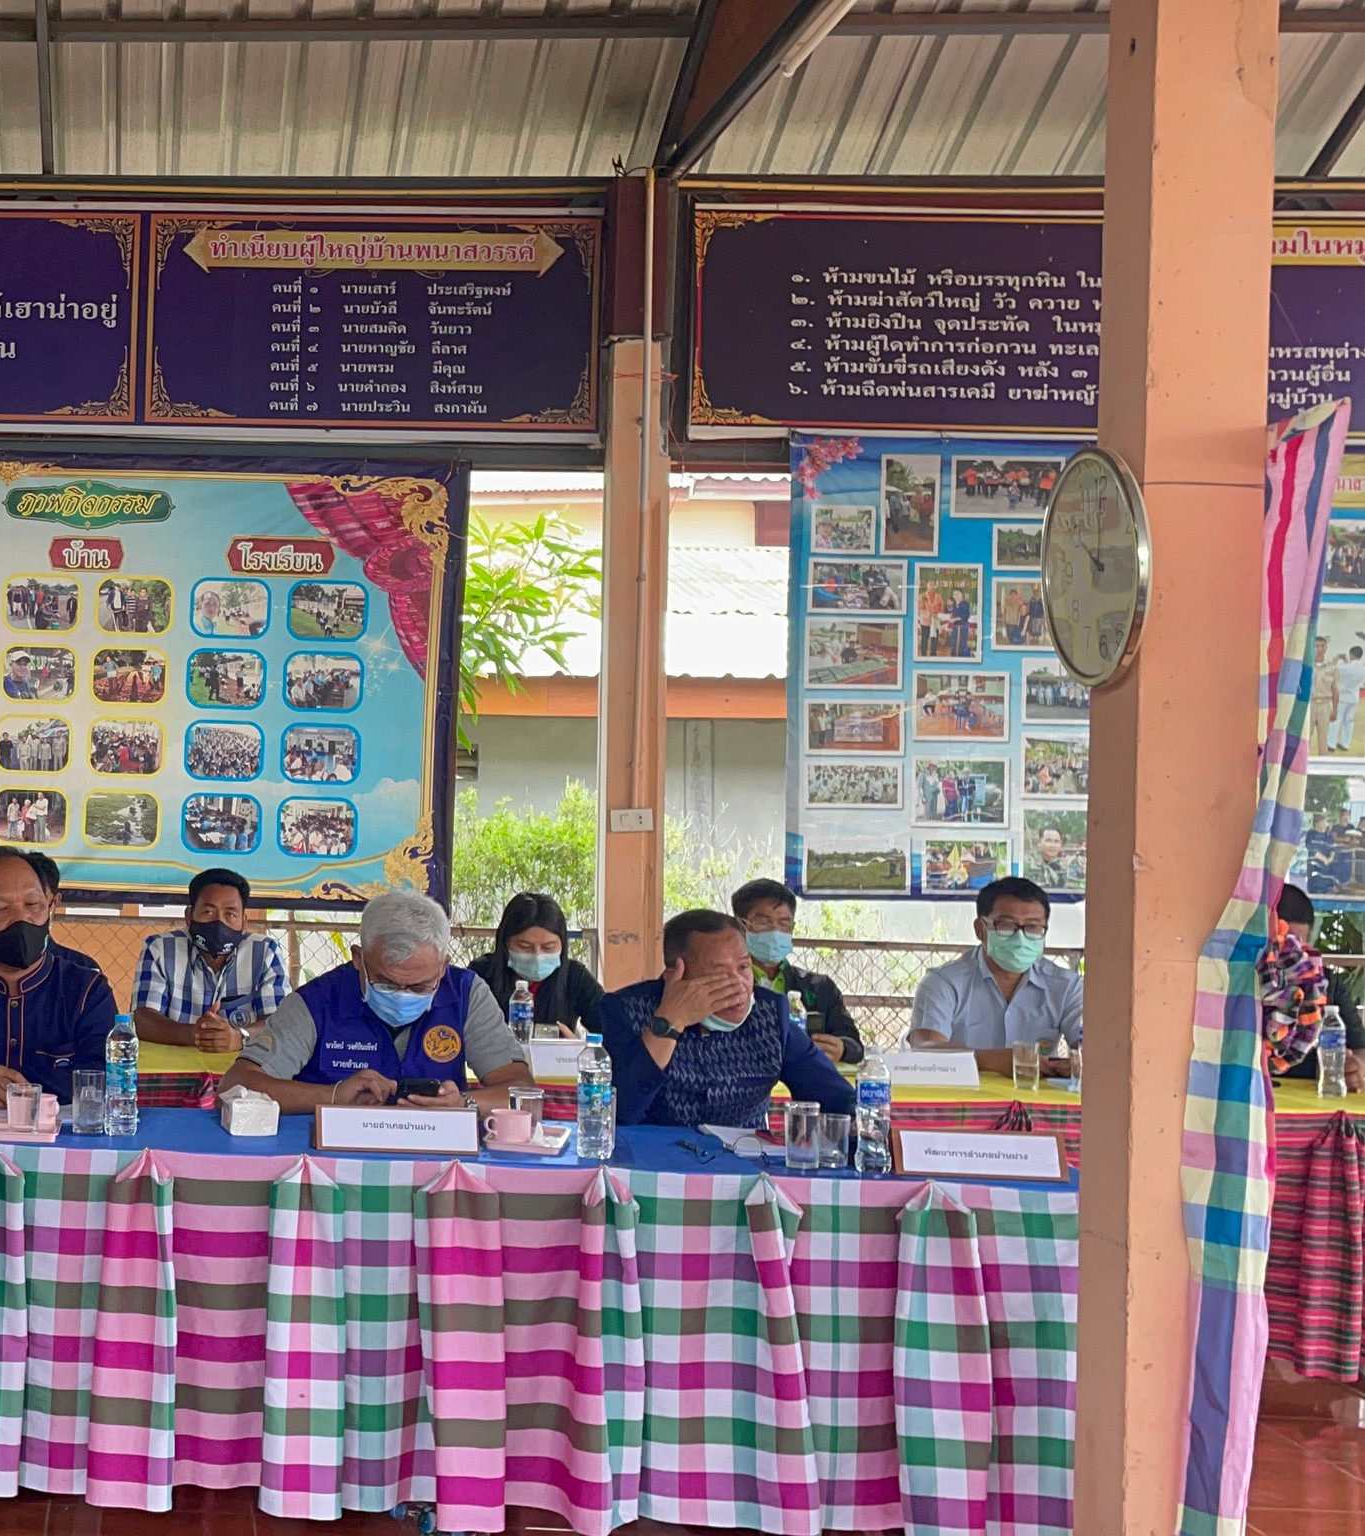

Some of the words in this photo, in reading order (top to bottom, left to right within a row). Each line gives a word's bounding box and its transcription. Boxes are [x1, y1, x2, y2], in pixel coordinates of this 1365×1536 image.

[210, 233, 535, 265] ทำเนียบผู้ใหญ่บ้านพนาสวรรค์
[272, 277, 302, 293] คนที่
[341, 281, 396, 294] นายเสาร์
[427, 282, 511, 299] ประเสริฐพงษ์
[823, 267, 916, 286] ห้ามขนไม้
[927, 270, 1065, 292] หรือบรรทุกหิน
[272, 297, 301, 313] คนที่
[828, 289, 980, 312] ห้ามฆ่าสัตว์ใหญ่
[993, 292, 1016, 310] วัว
[1029, 298, 1080, 311] ควาย
[271, 317, 301, 333] คนที่
[826, 312, 922, 330] ห้ามยิงปืน
[934, 315, 1030, 334] จุดประทัด
[270, 336, 300, 352] คนที่
[825, 334, 1037, 356] ห้ามผู้ใดทำการก่อกวน
[1269, 342, 1365, 360] หรสพต่า
[270, 356, 299, 372] คนที่
[824, 354, 1006, 377] ห้ามขับขี่รถเสียงดัง
[1018, 361, 1059, 377] หลัง
[269, 375, 299, 391] คนที่
[821, 378, 996, 400] ห้ามฉีดพ่นสารเคมี
[1008, 383, 1099, 405] ยาฆ่าหญ้
[269, 395, 298, 411] คนที่
[341, 399, 411, 414] นายประวิน
[17, 486, 162, 517] ภาพกิจกรรม
[62, 541, 111, 569] บ้าน
[238, 545, 323, 572] โรงเรียน
[362, 1121, 436, 1131] นายอำเภอบ้านม่วง
[923, 1147, 1028, 1160] พัฒนาการอำเภอบ้านม่วง
